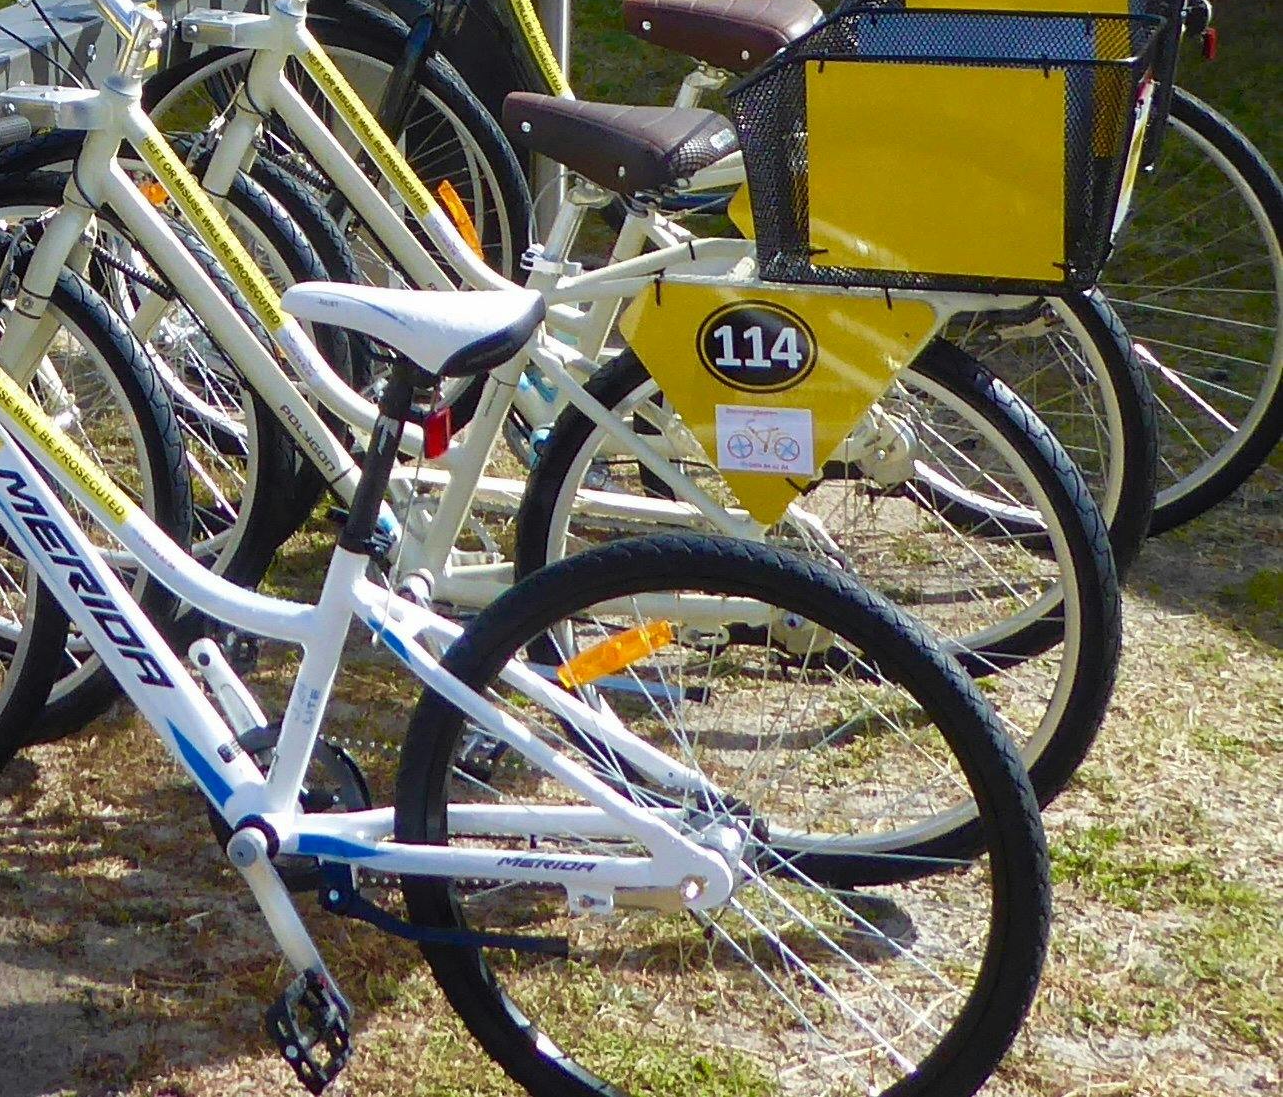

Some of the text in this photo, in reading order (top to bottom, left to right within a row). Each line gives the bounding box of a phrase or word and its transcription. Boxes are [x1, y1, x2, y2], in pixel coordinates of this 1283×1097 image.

[143, 138, 281, 324] HEFT OR MISUSE WILL BE PROSECUTED
[714, 325, 802, 369] 114
[14, 404, 38, 434] WILL
[39, 427, 54, 448] BE
[54, 445, 126, 516] PROSECUTED
[497, 857, 597, 872] MERIDA
